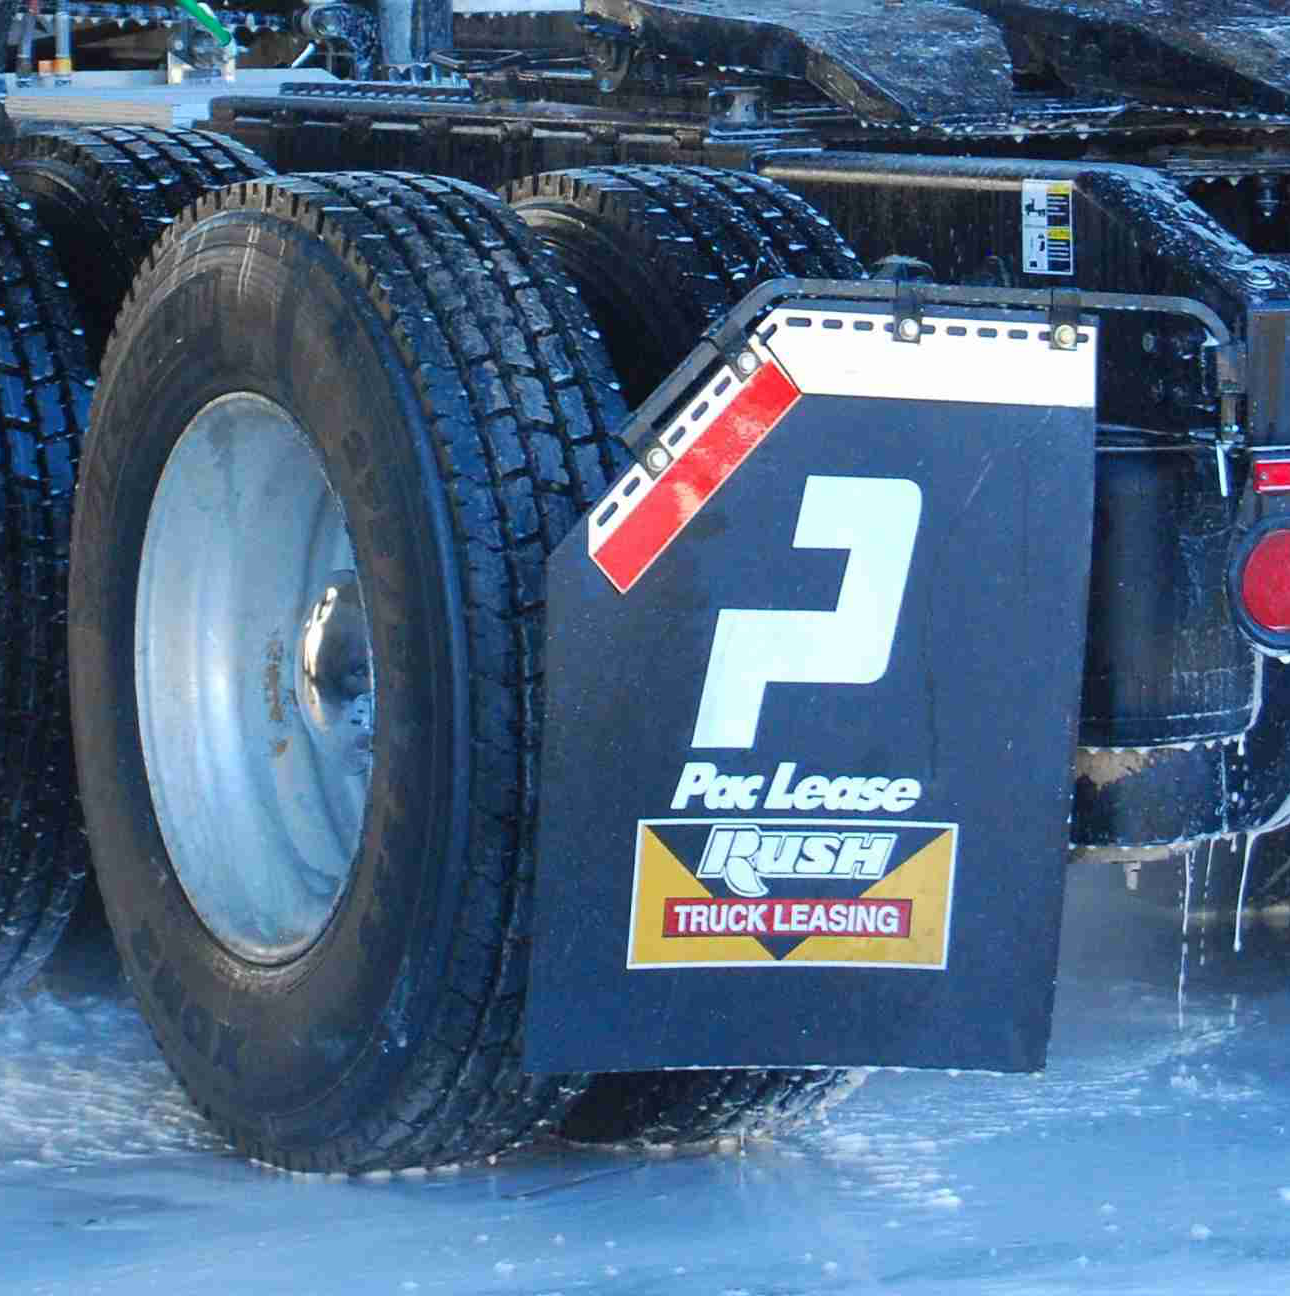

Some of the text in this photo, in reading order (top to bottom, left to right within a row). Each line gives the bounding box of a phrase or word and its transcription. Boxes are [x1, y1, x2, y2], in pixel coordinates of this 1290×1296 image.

[670, 762, 922, 812] Pac Lease
[696, 824, 898, 898] RUSH
[673, 904, 902, 934] TRUCK LEASING
